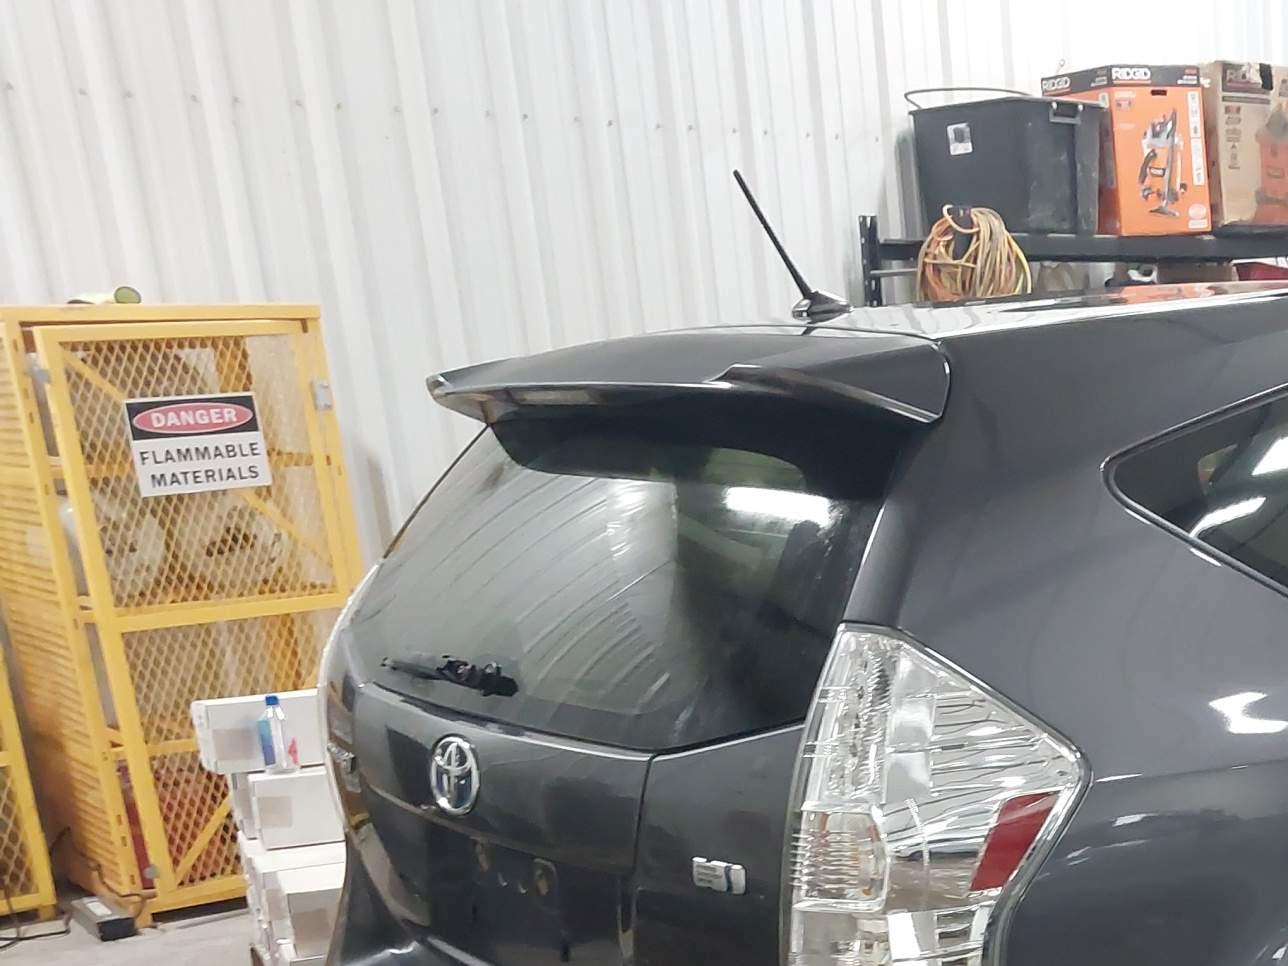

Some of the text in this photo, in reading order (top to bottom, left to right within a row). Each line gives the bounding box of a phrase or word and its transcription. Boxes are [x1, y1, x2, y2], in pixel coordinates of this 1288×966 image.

[1111, 67, 1151, 80] RIDGID
[151, 408, 237, 428] DANGER
[139, 442, 261, 465] FLAMMABLE
[151, 465, 259, 488] MATERIALS
